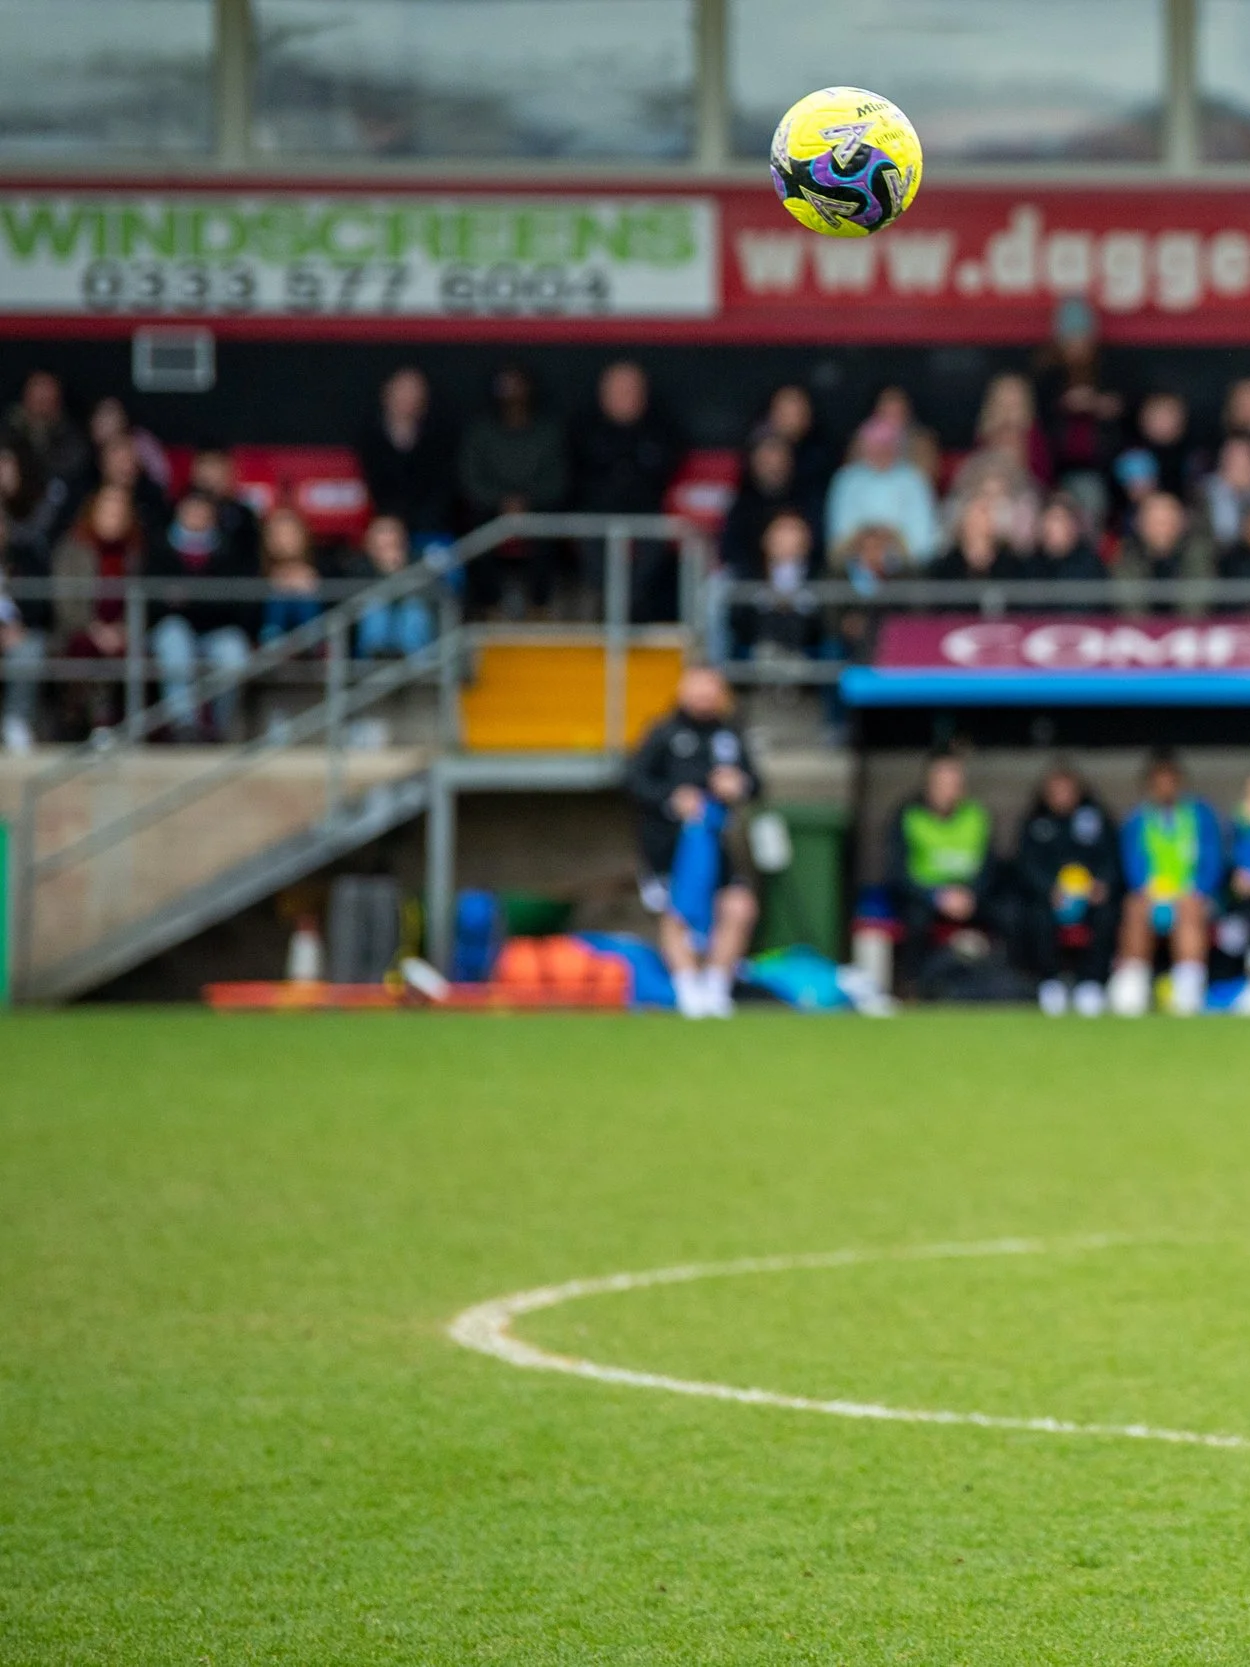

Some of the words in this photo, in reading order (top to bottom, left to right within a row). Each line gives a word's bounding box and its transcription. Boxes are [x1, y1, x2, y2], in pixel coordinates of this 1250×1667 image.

[1, 203, 698, 266] WINDSCREENS
[80, 263, 260, 311] 0333
[283, 263, 412, 311] 577
[438, 263, 613, 311] 6004
